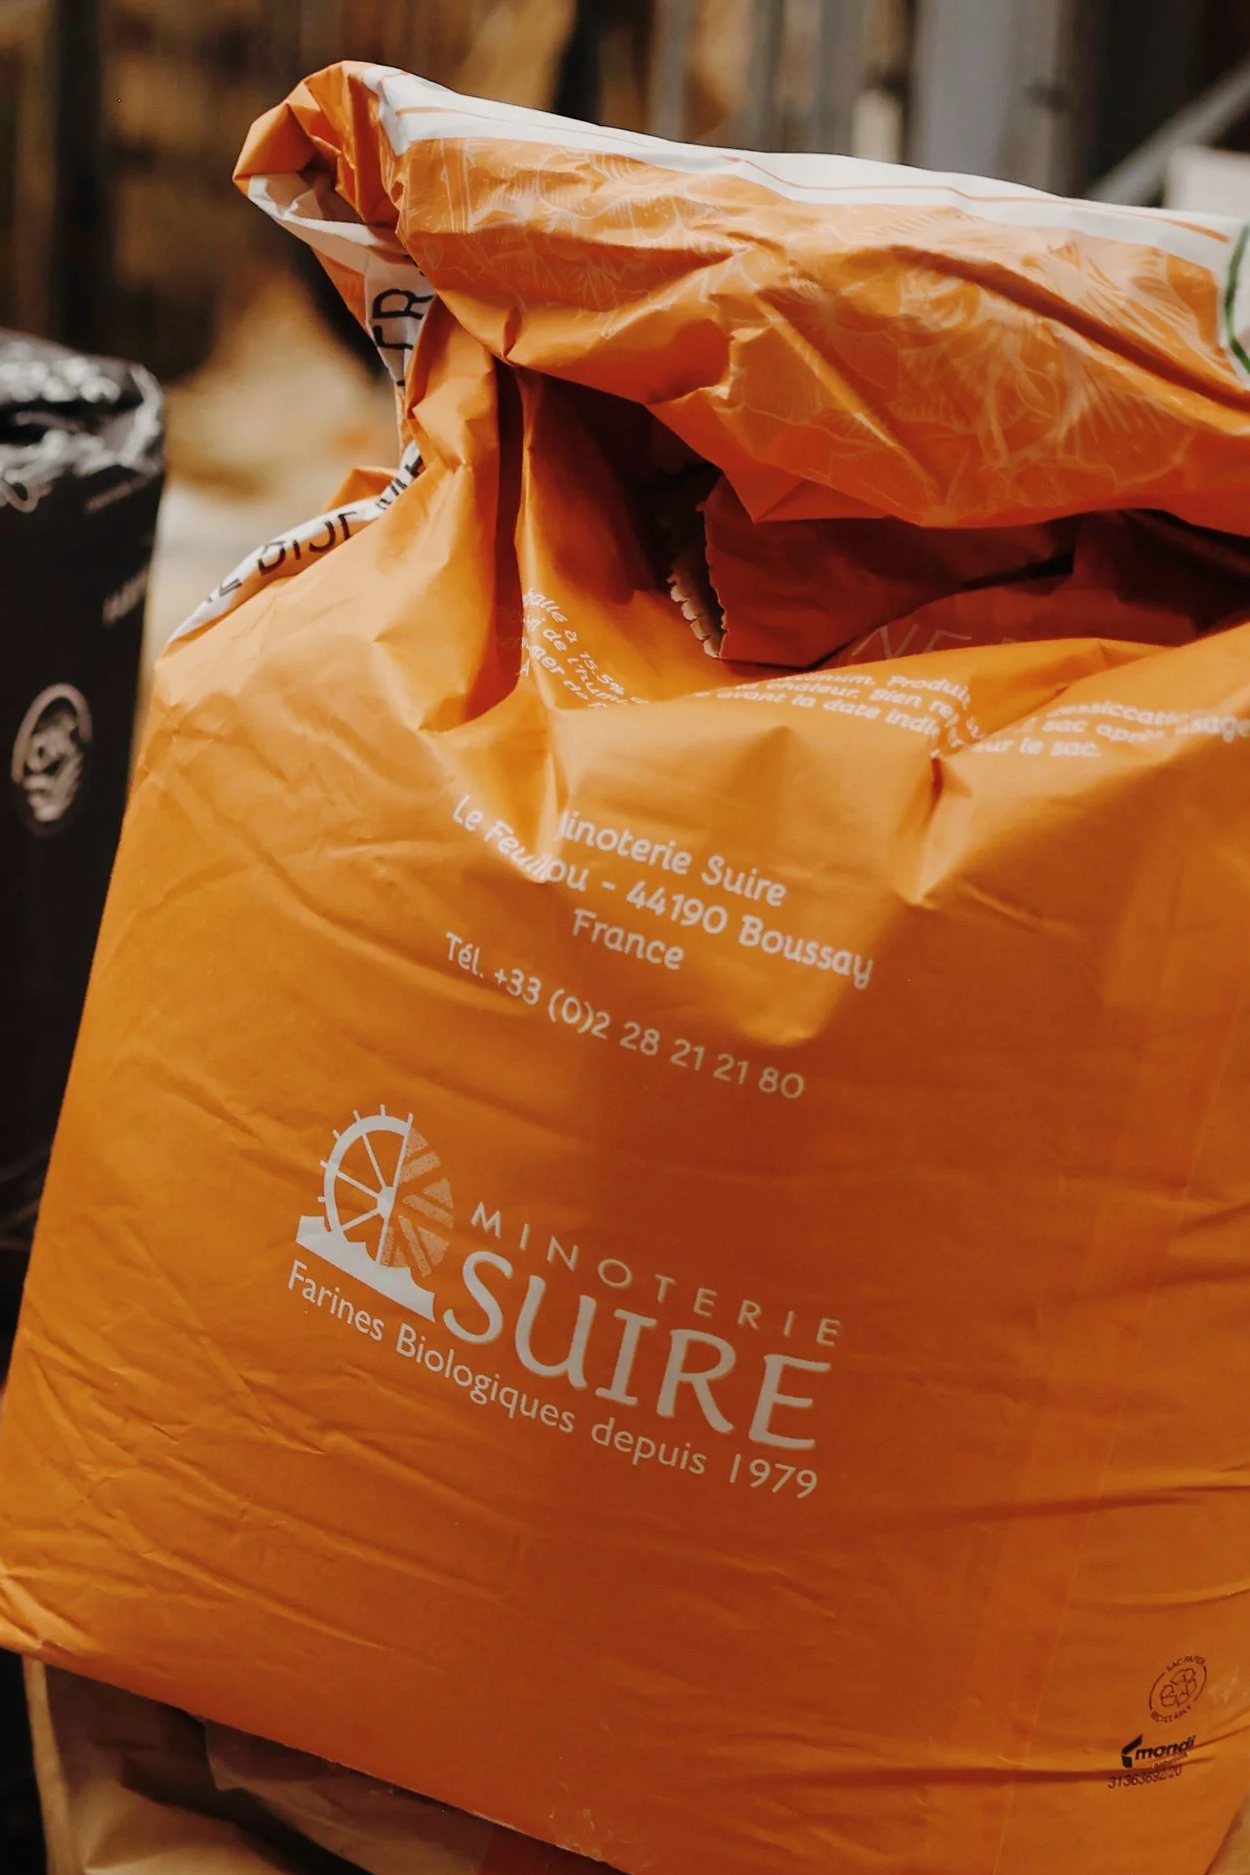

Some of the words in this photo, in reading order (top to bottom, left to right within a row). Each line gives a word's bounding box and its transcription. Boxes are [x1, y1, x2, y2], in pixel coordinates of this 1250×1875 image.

[452, 795, 483, 832] Le
[625, 879, 729, 938] 44190
[739, 915, 875, 991] Boussay
[555, 811, 693, 877] inoterie
[701, 854, 788, 909] Suire
[570, 907, 686, 972] France
[444, 931, 487, 980] Tél.
[492, 964, 543, 1009] +33
[547, 987, 612, 1042] (0)2
[619, 1020, 661, 1058] 28
[669, 1036, 706, 1073] 21
[712, 1050, 750, 1086] 21
[757, 1065, 806, 1102] 80
[442, 1250, 832, 1451] SUIRE
[470, 1200, 843, 1348] MINOTERIE
[287, 1258, 385, 1342] Farines
[394, 1320, 576, 1435] Biologiques
[590, 1415, 709, 1477] depuis
[728, 1453, 819, 1501] 1979
[1134, 1734, 1197, 1762] mondi
